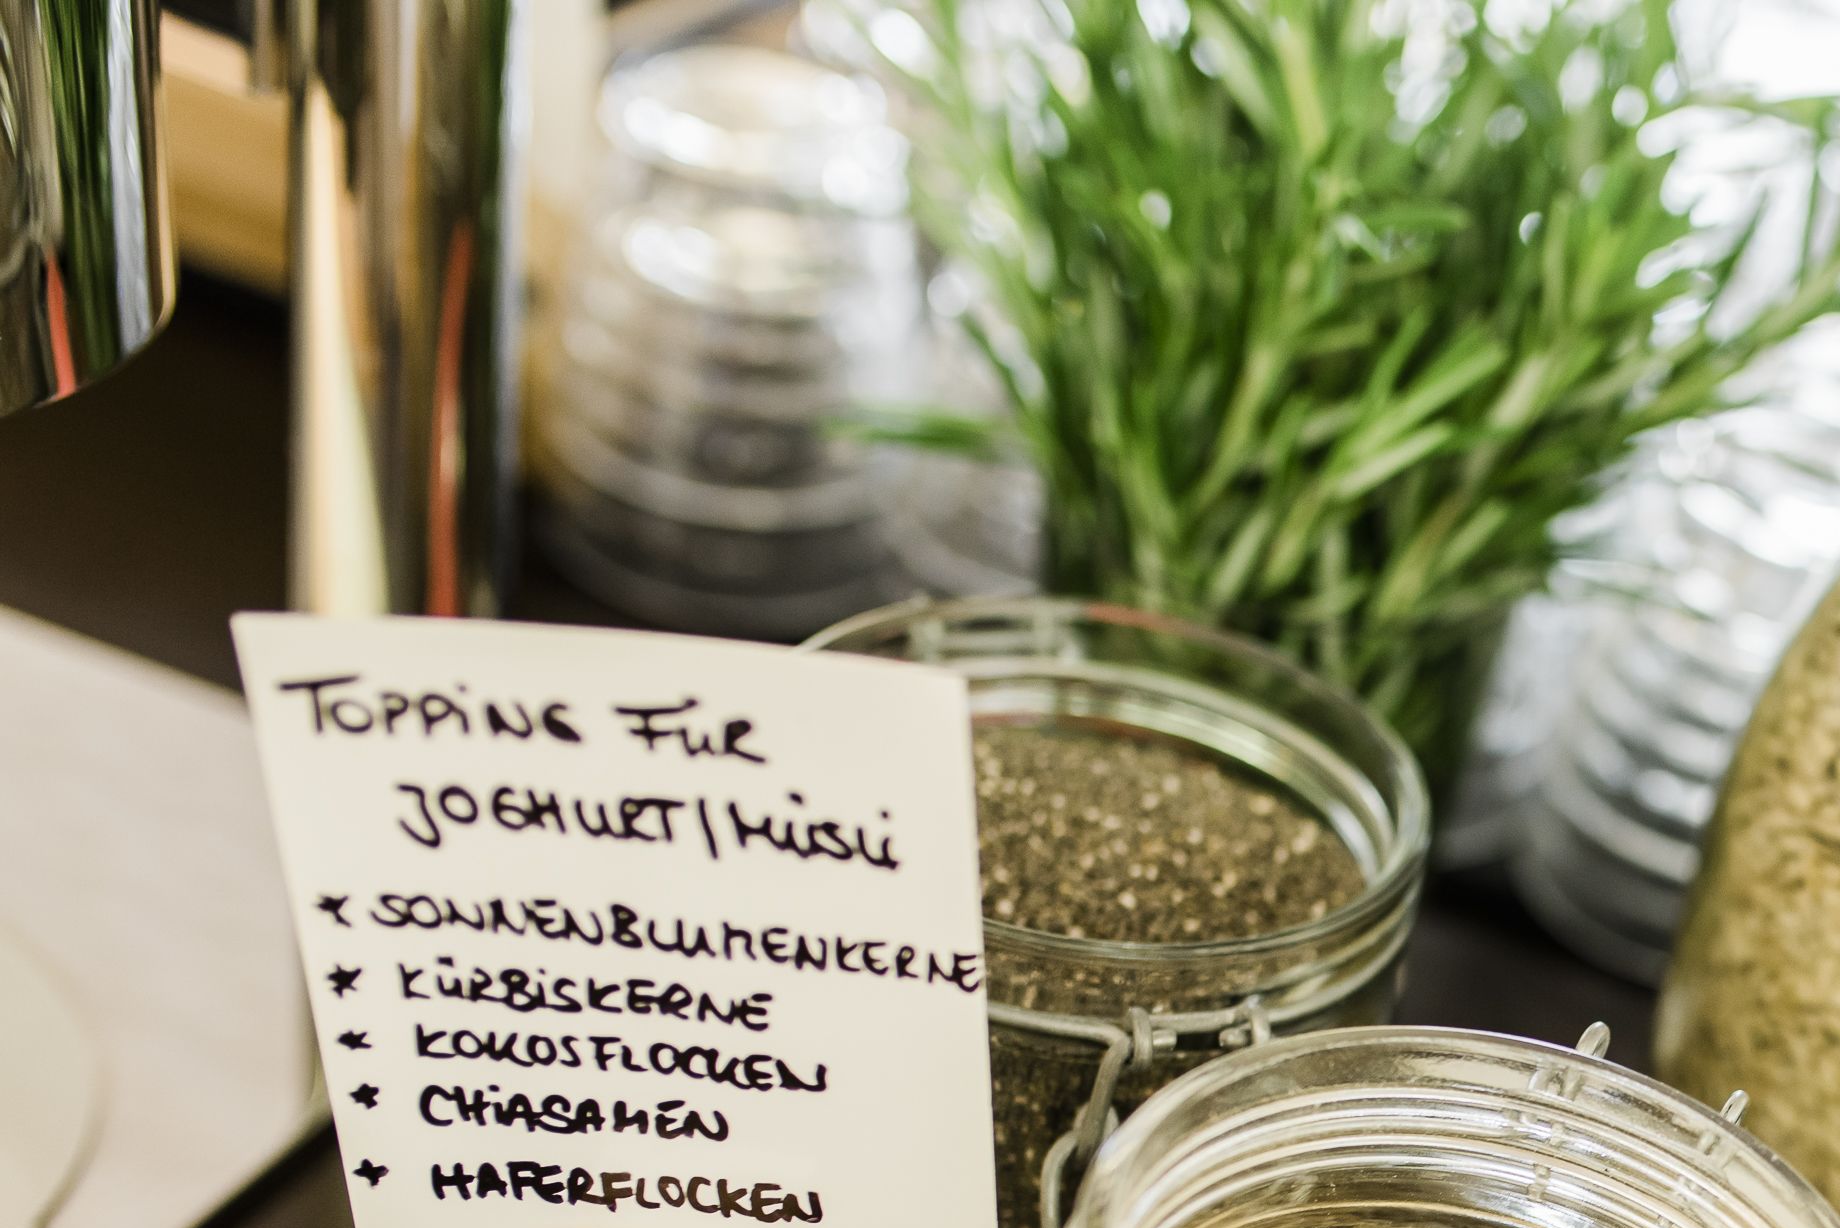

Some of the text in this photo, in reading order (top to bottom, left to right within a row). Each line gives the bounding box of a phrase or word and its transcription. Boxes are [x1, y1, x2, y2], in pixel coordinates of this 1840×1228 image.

[369, 893, 983, 994] SONNENBLUMENKERNE
[414, 1023, 828, 1093] KOKOSFLOCKEN
[430, 1160, 824, 1224] HAFERFLOCKEN
